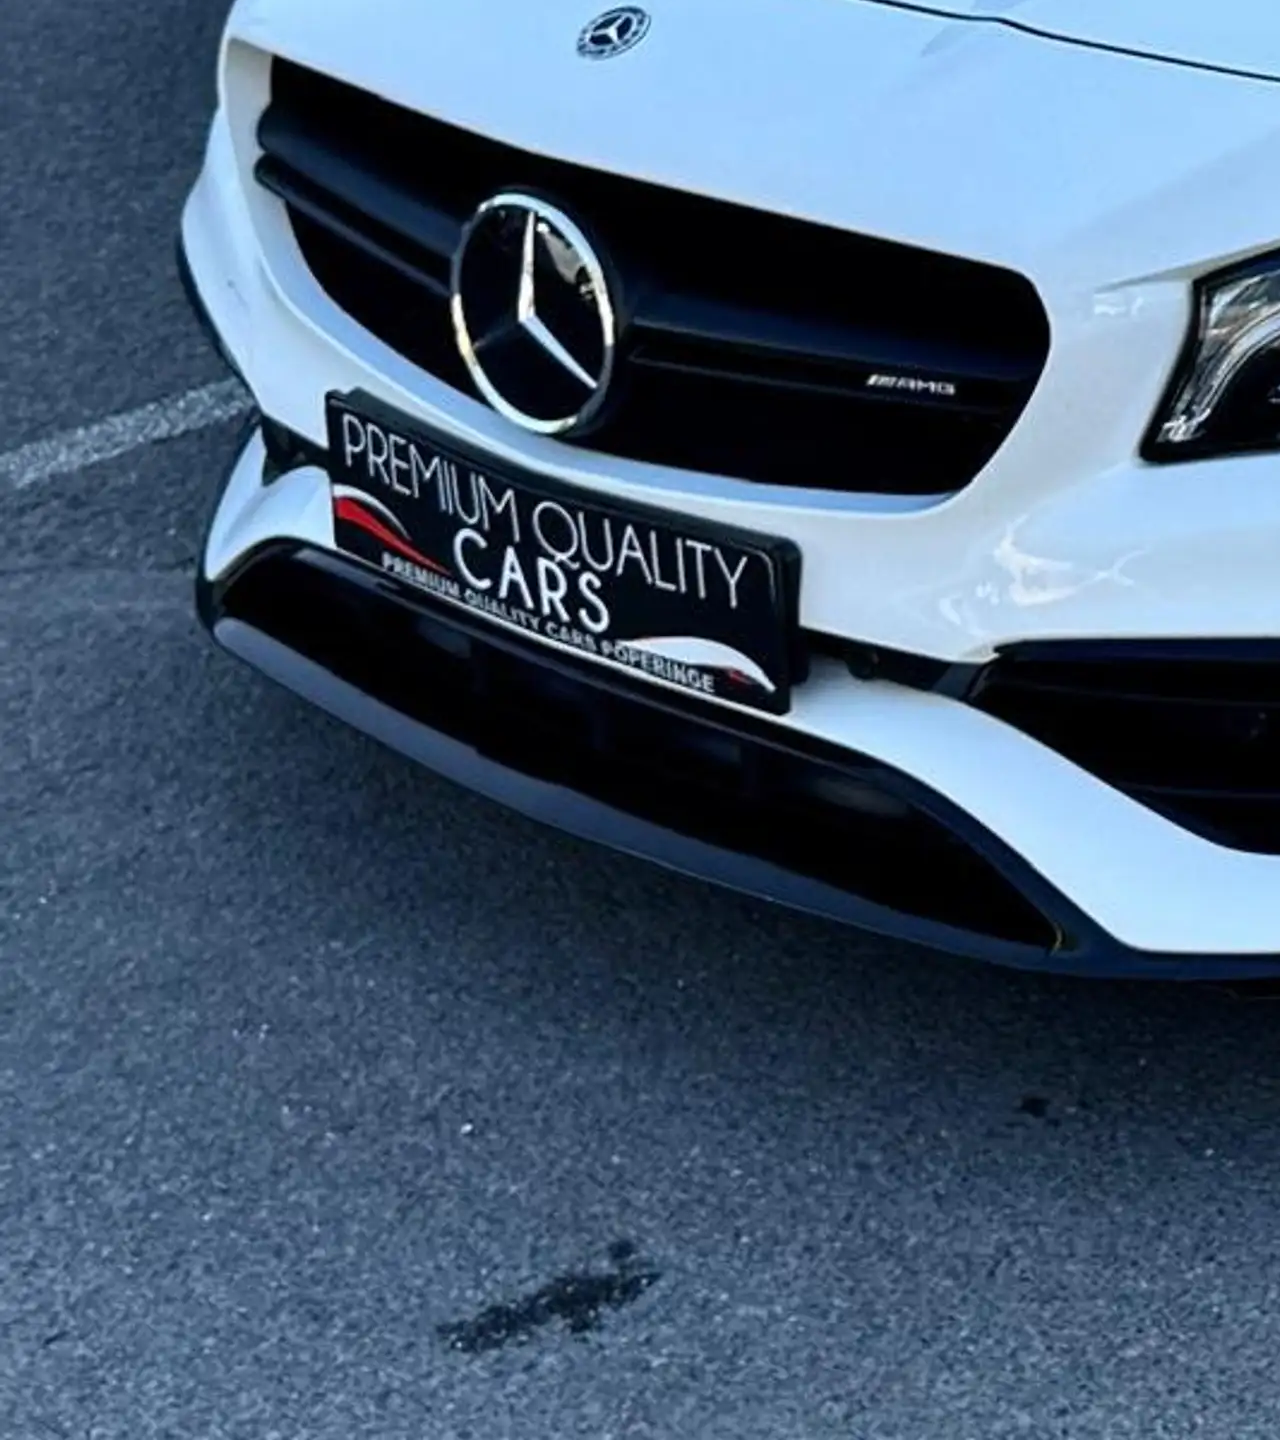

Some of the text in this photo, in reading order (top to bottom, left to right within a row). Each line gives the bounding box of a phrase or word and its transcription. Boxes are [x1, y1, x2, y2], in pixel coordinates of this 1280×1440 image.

[343, 414, 748, 608] PREMIUM QUALITY
[382, 551, 460, 597] PREMIUM
[464, 588, 540, 630] QUALITY
[545, 620, 596, 652] CARS
[453, 528, 609, 633] CARS
